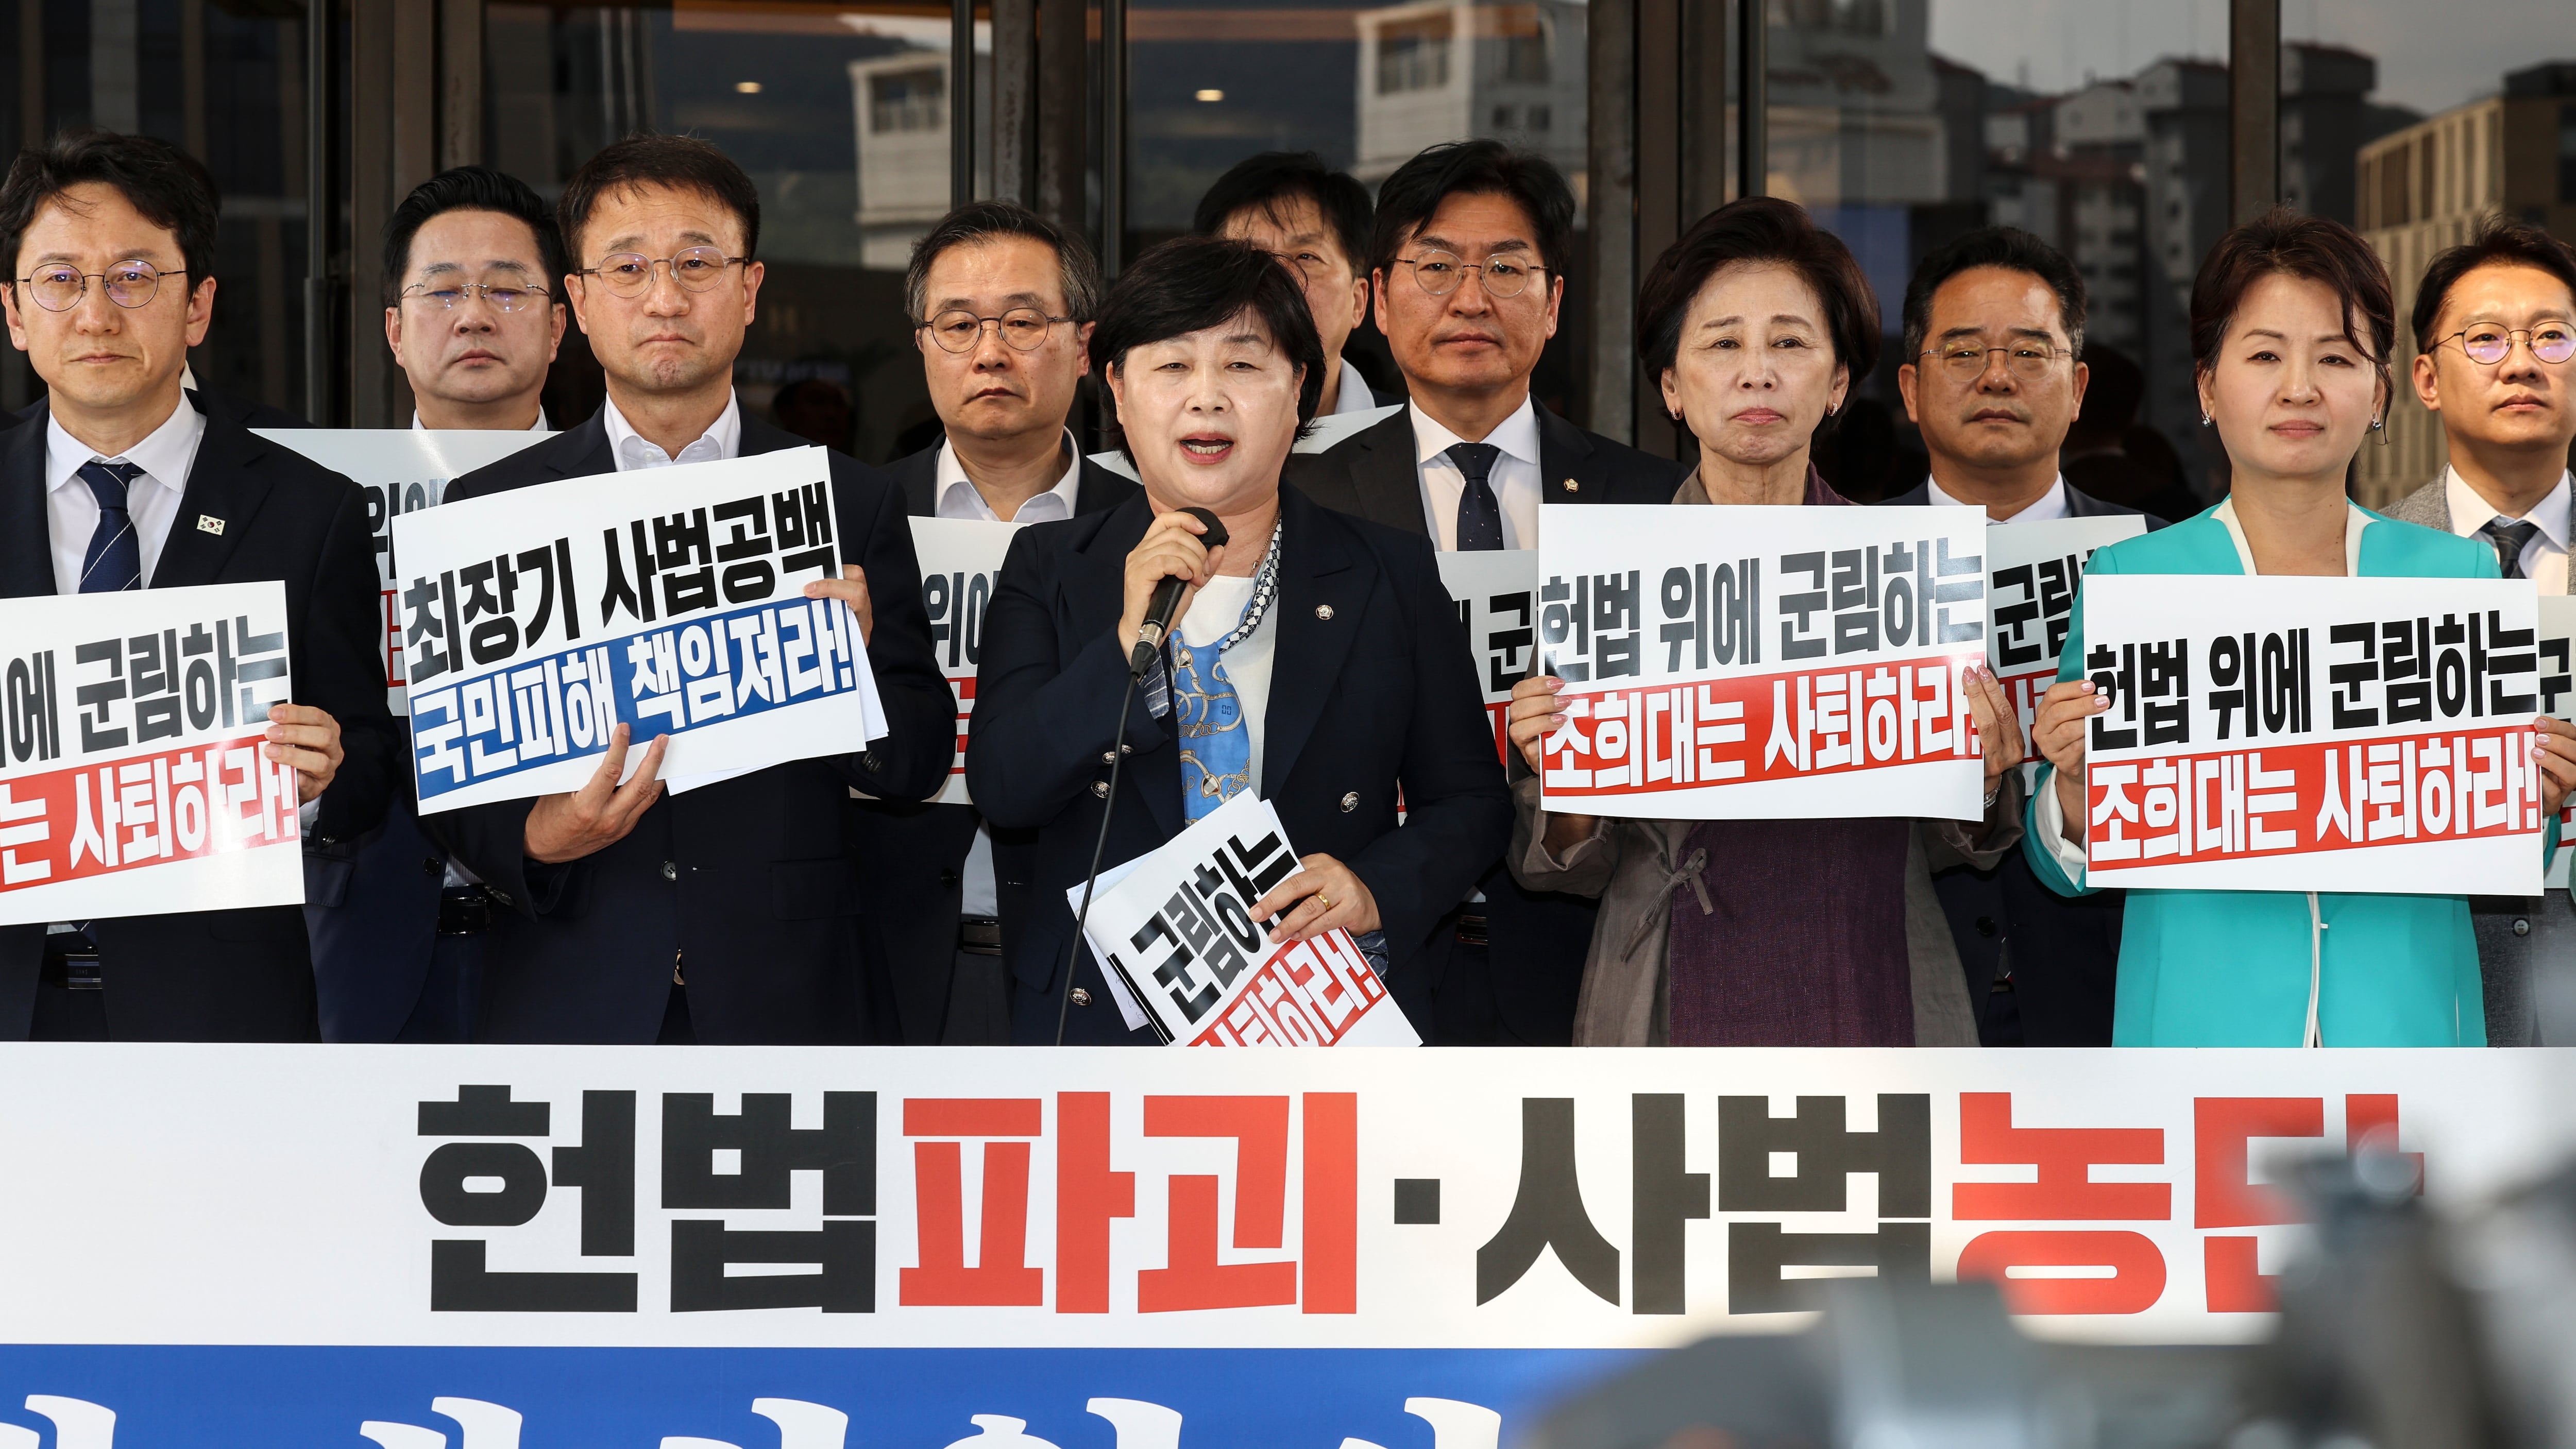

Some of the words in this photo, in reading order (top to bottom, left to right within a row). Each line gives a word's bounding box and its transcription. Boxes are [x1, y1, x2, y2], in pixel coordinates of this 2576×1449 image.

[403, 537, 581, 686] 최장기
[600, 481, 838, 628] 사법공백
[1489, 591, 1538, 693] 군
[1541, 570, 1640, 682] 헌법
[1659, 557, 1760, 672] 위에
[1779, 537, 1984, 661] 군림하는
[1992, 549, 2095, 668] 군림
[0, 650, 60, 768] 에
[75, 616, 289, 753] 군림하는
[414, 645, 617, 783] 국민피해
[627, 598, 853, 730] 책임져라!
[1545, 682, 1745, 790] 조희대는
[2087, 639, 2189, 751] 헌법
[2209, 628, 2311, 740] 위에
[2330, 610, 2537, 729] 군림하는
[70, 740, 296, 870] 사퇴하라!
[2091, 752, 2296, 862] 조희대는
[2316, 731, 2537, 843] 사퇴하라!
[1130, 831, 1309, 1026] 군림하는
[1199, 928, 1382, 1047] 퇴하라!
